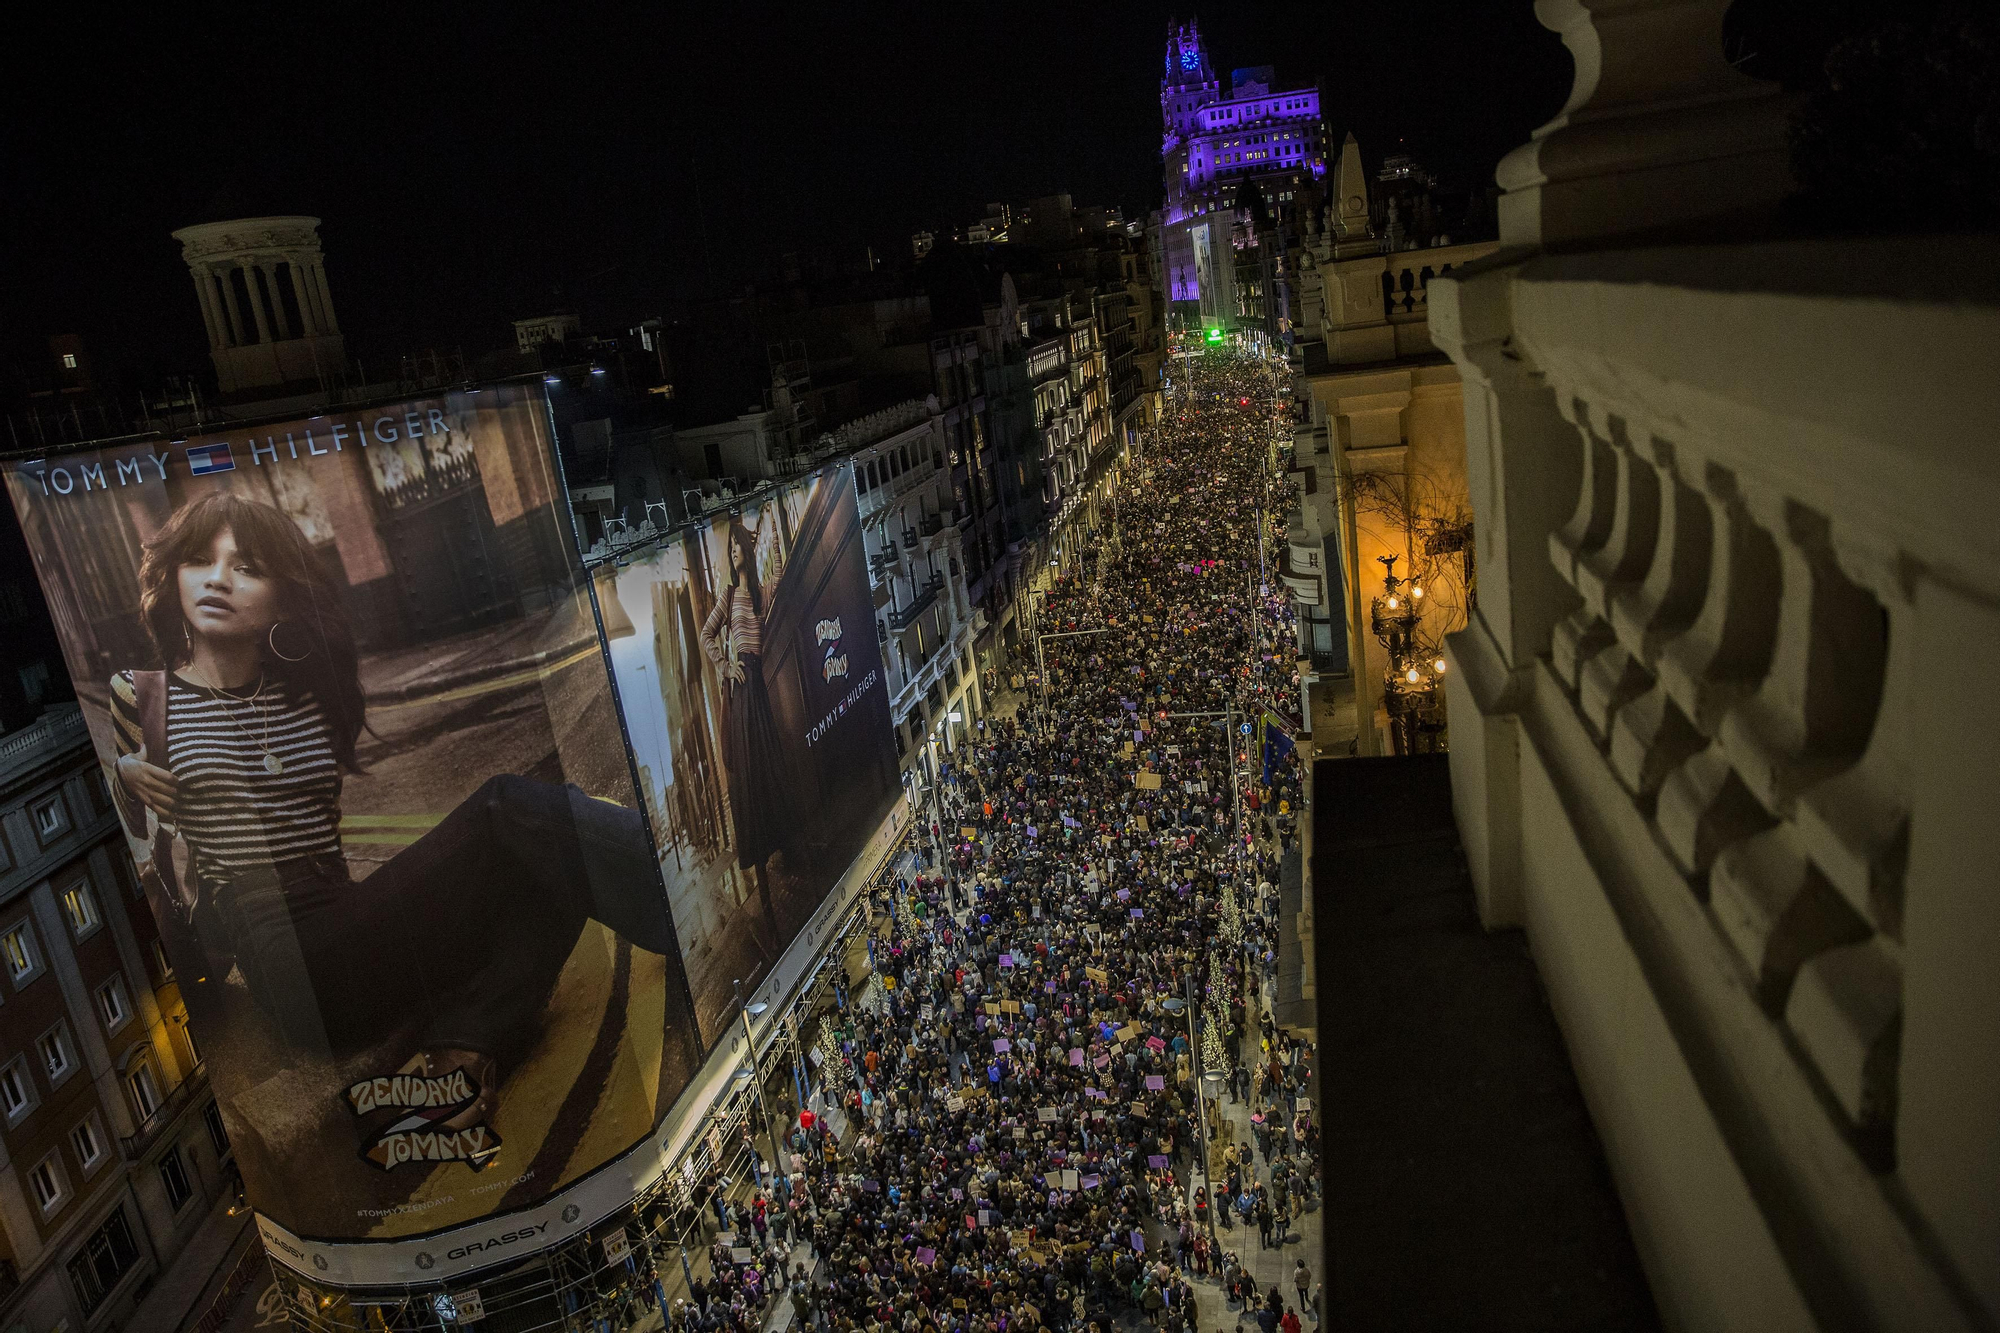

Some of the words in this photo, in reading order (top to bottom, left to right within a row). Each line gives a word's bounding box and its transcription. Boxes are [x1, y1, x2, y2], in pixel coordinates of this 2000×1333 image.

[37, 452, 169, 496] TOMMY
[249, 408, 450, 465] HILFIGER
[824, 653, 848, 684] TOMMY
[805, 707, 838, 748] TOMMY
[847, 669, 877, 708] HILFIGER
[815, 898, 839, 934] GRASSY
[351, 1070, 474, 1115] ZENDAYA
[378, 1126, 486, 1170] TOMMY
[357, 1195, 455, 1217] #TOMMYXZENDAYA
[447, 1220, 549, 1260] GRASSY
